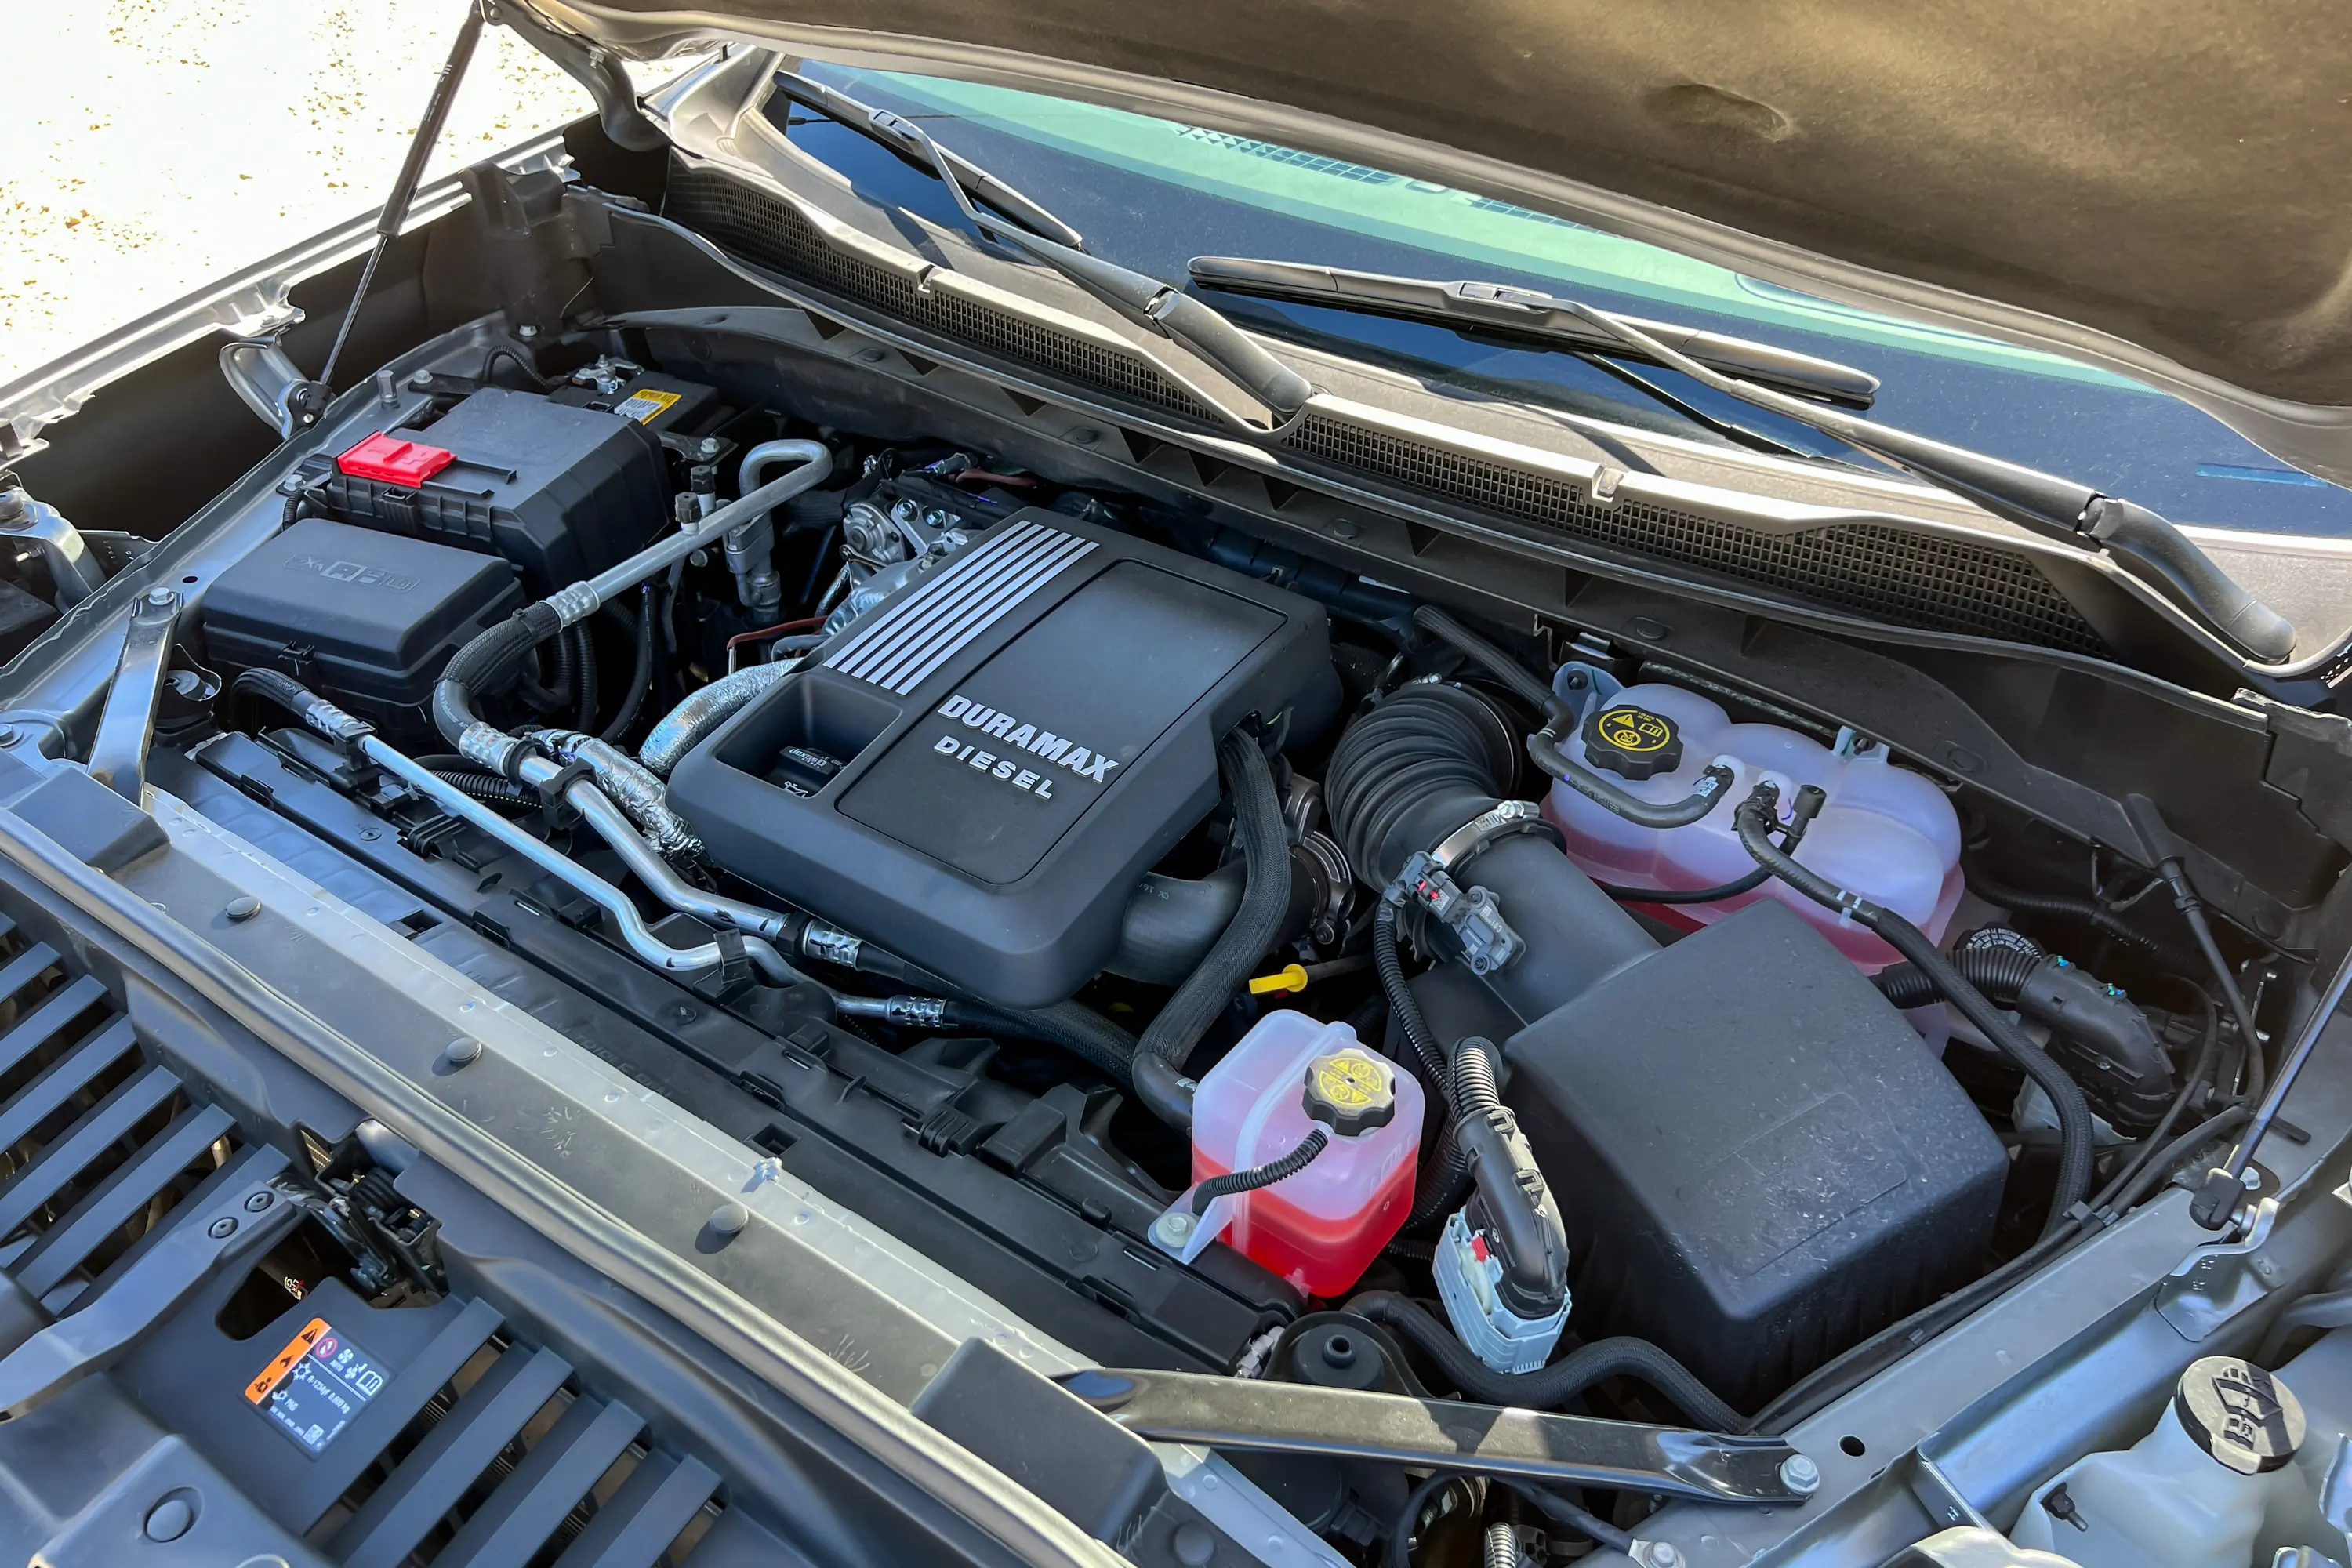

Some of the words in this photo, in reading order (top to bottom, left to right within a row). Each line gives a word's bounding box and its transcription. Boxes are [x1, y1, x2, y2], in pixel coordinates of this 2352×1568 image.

[934, 735, 1053, 799] DIESEL
[937, 695, 1119, 784] DURAMAX
[285, 1398, 299, 1411] PAG
